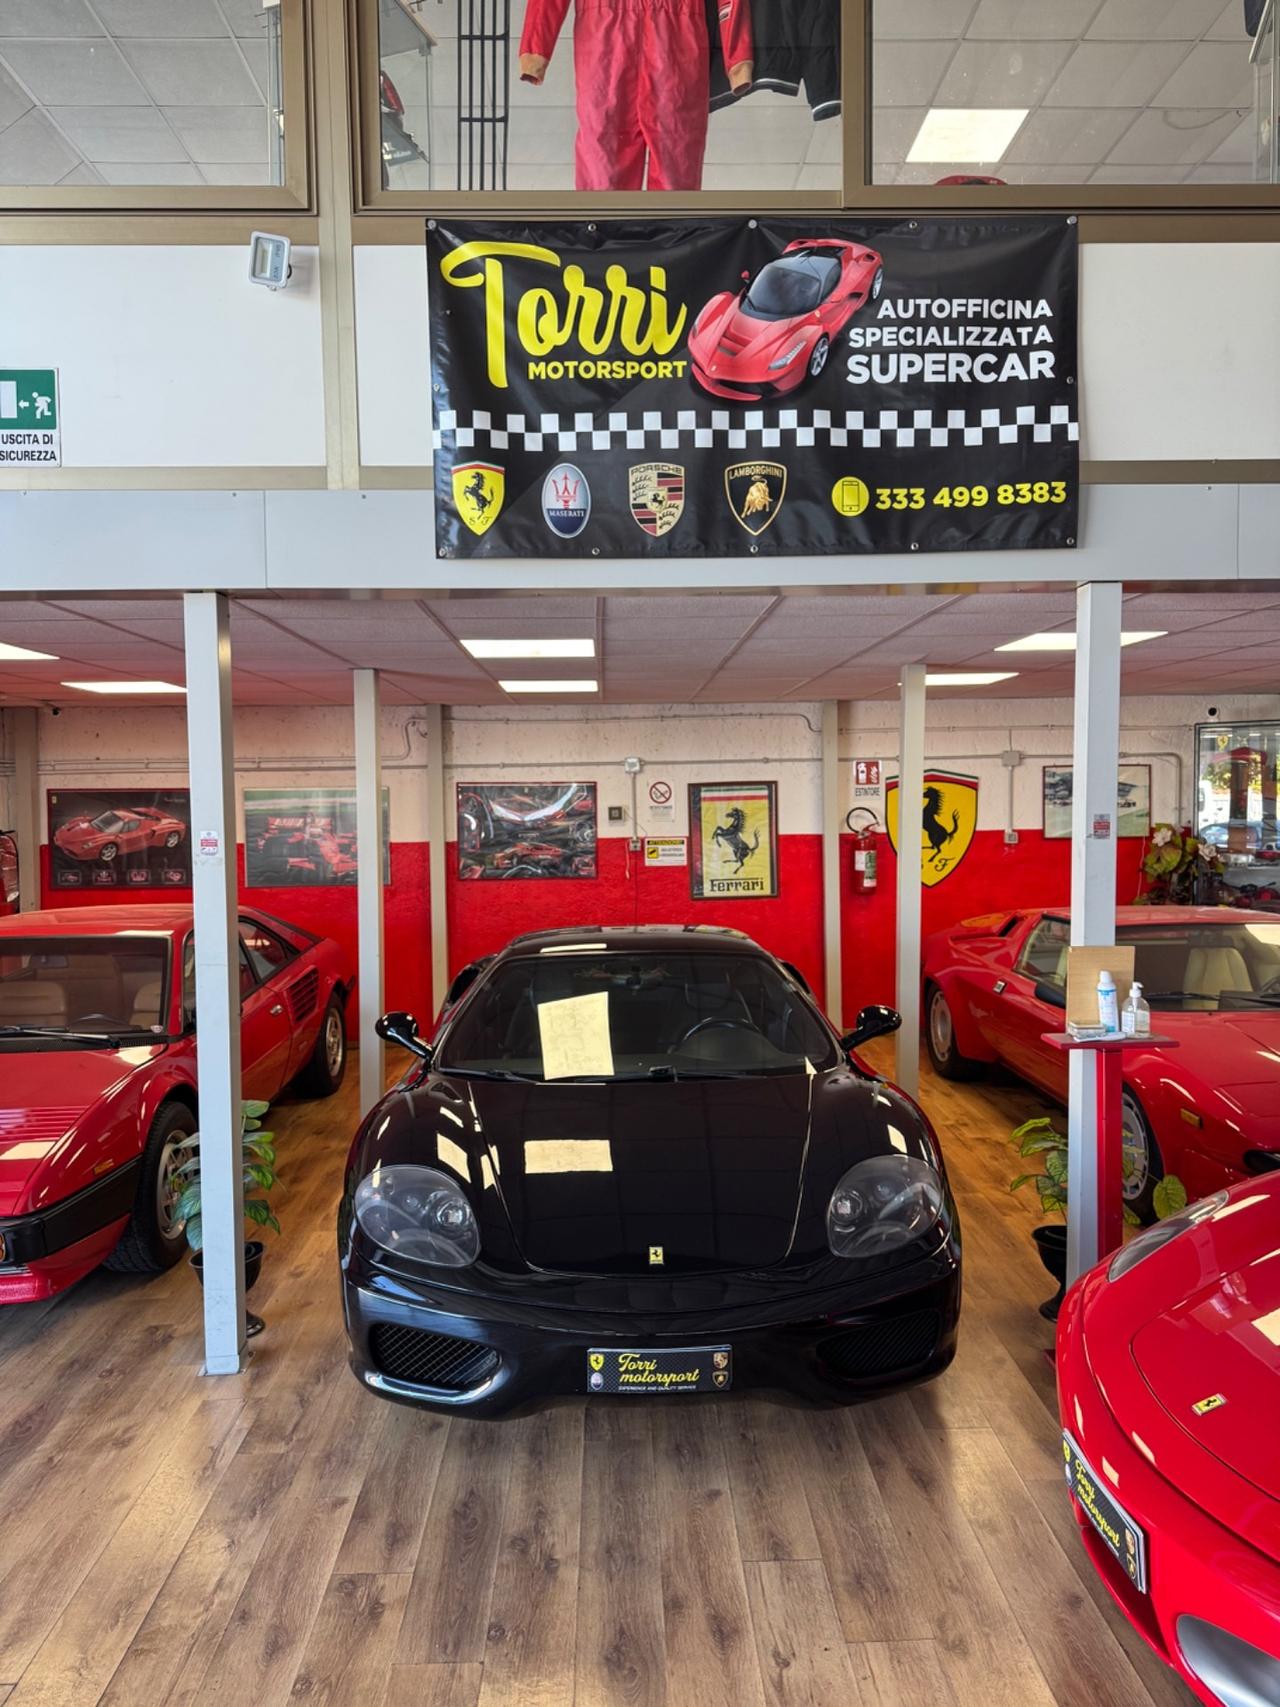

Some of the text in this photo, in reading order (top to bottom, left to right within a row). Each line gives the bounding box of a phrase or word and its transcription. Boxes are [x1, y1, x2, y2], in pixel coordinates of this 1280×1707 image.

[440, 241, 688, 388] Torri
[877, 299, 1053, 320] AUTOFFICINA
[849, 325, 1054, 348] SPECIALIZZATA
[528, 361, 687, 380] MOTORSPORT
[846, 350, 1056, 384] SUPERCAR
[1, 434, 53, 445] USCITA DI
[0, 450, 57, 461] SICUREZZA
[631, 464, 683, 475] PORSCHE
[729, 465, 783, 479] LAMBORGHINI
[875, 481, 1067, 510] 333 499 8383
[549, 510, 585, 518] MASERATI
[709, 878, 764, 892] Ferrari
[618, 1353, 657, 1372] Torri
[619, 1368, 700, 1387] motorsport
